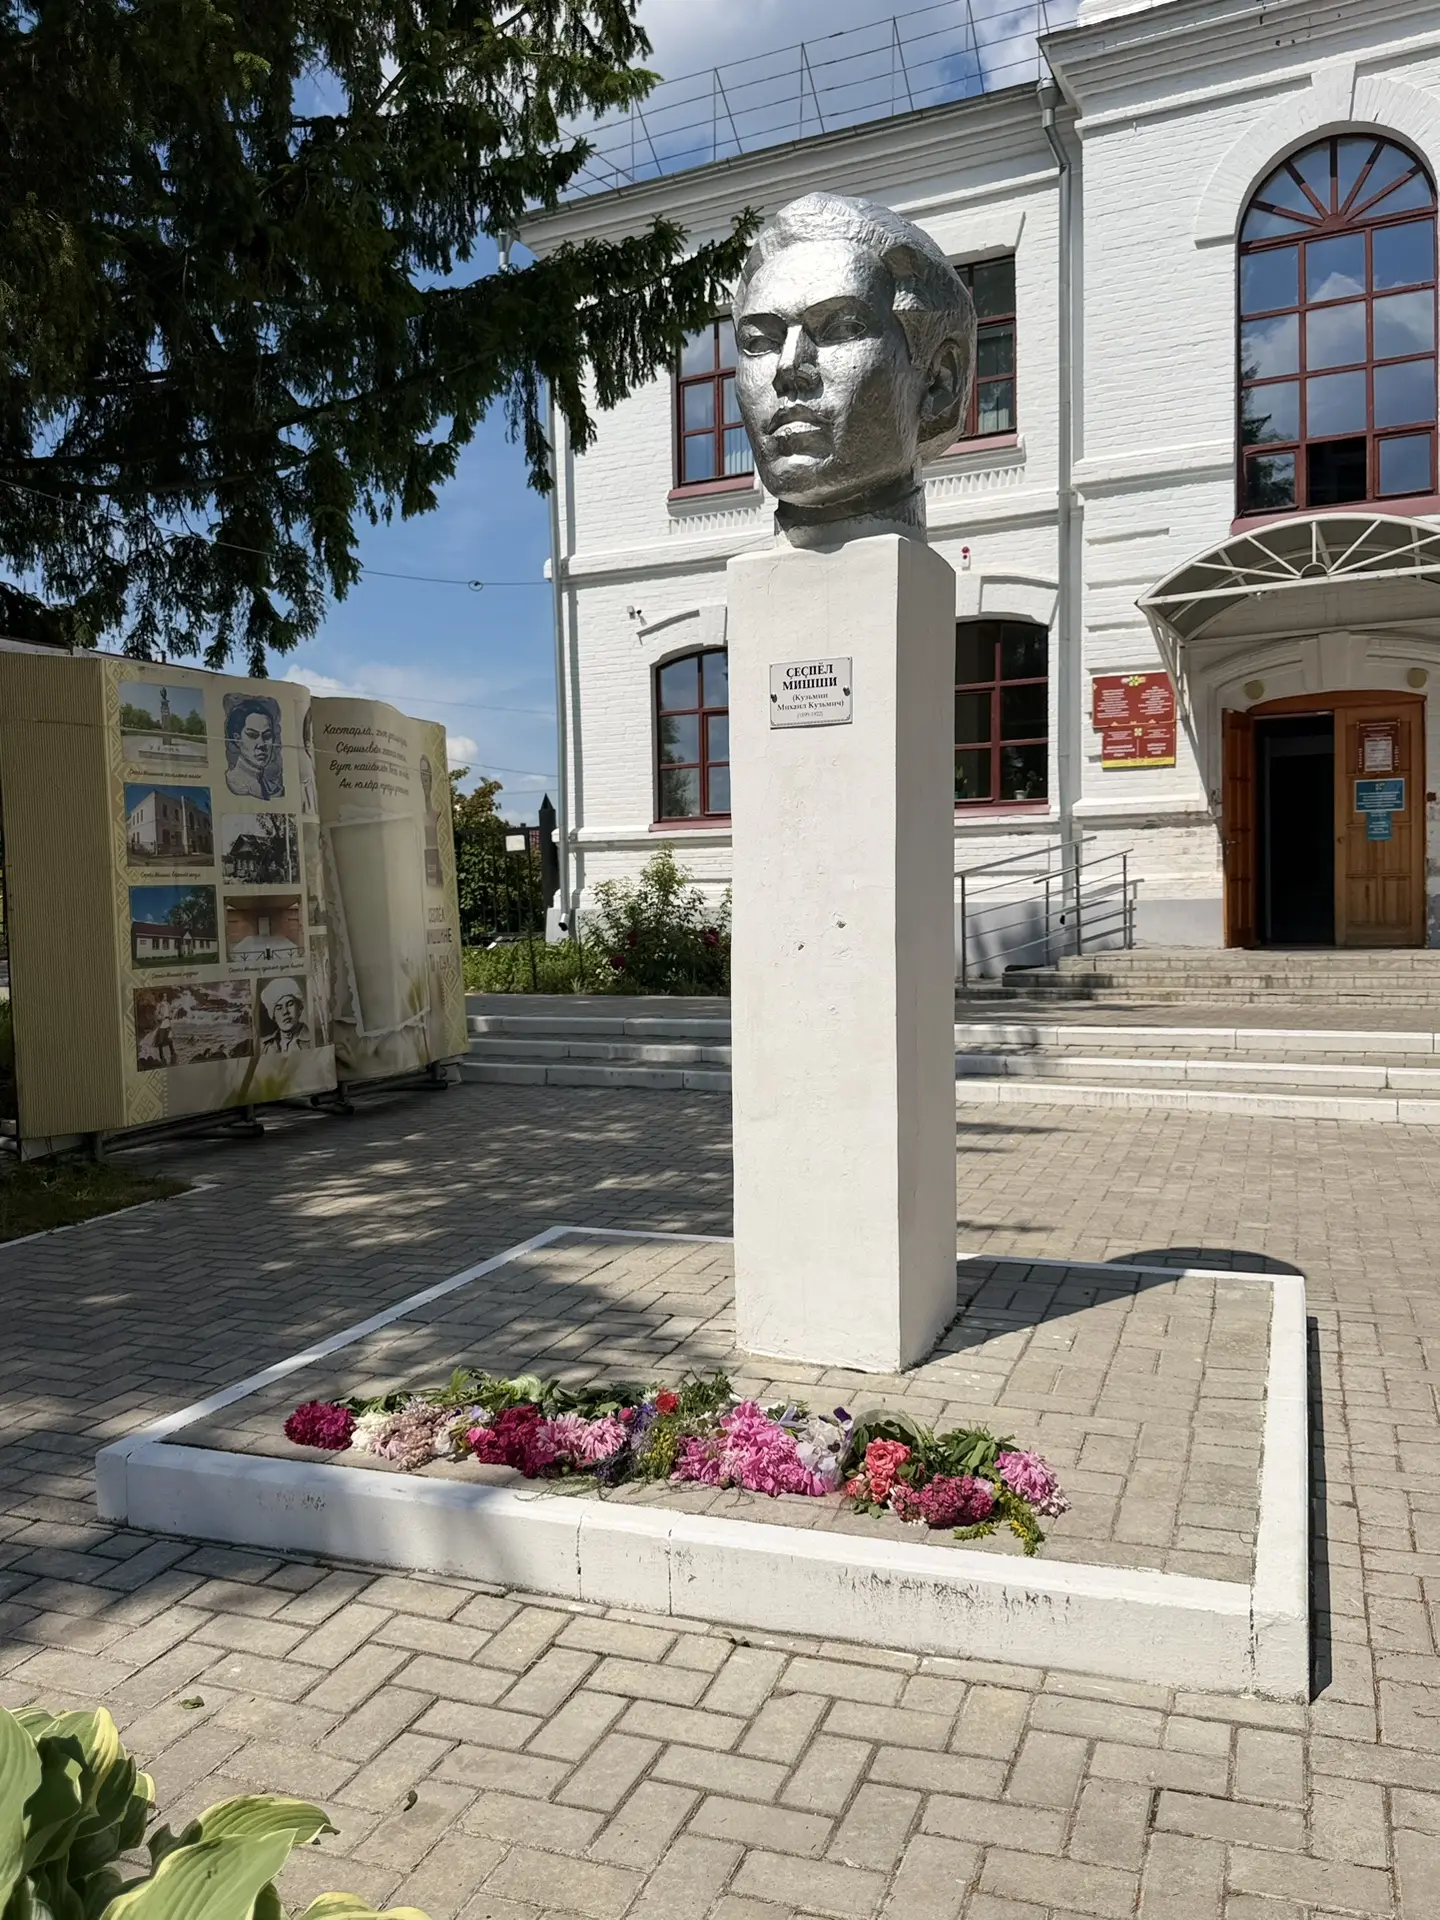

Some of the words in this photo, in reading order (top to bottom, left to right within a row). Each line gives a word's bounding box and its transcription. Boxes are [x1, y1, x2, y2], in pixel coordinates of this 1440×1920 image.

[782, 676, 838, 691] МИШШИ
[777, 703, 807, 711] Михаил
[808, 699, 844, 710] Кузьмич)
[329, 760, 352, 776] Вут
